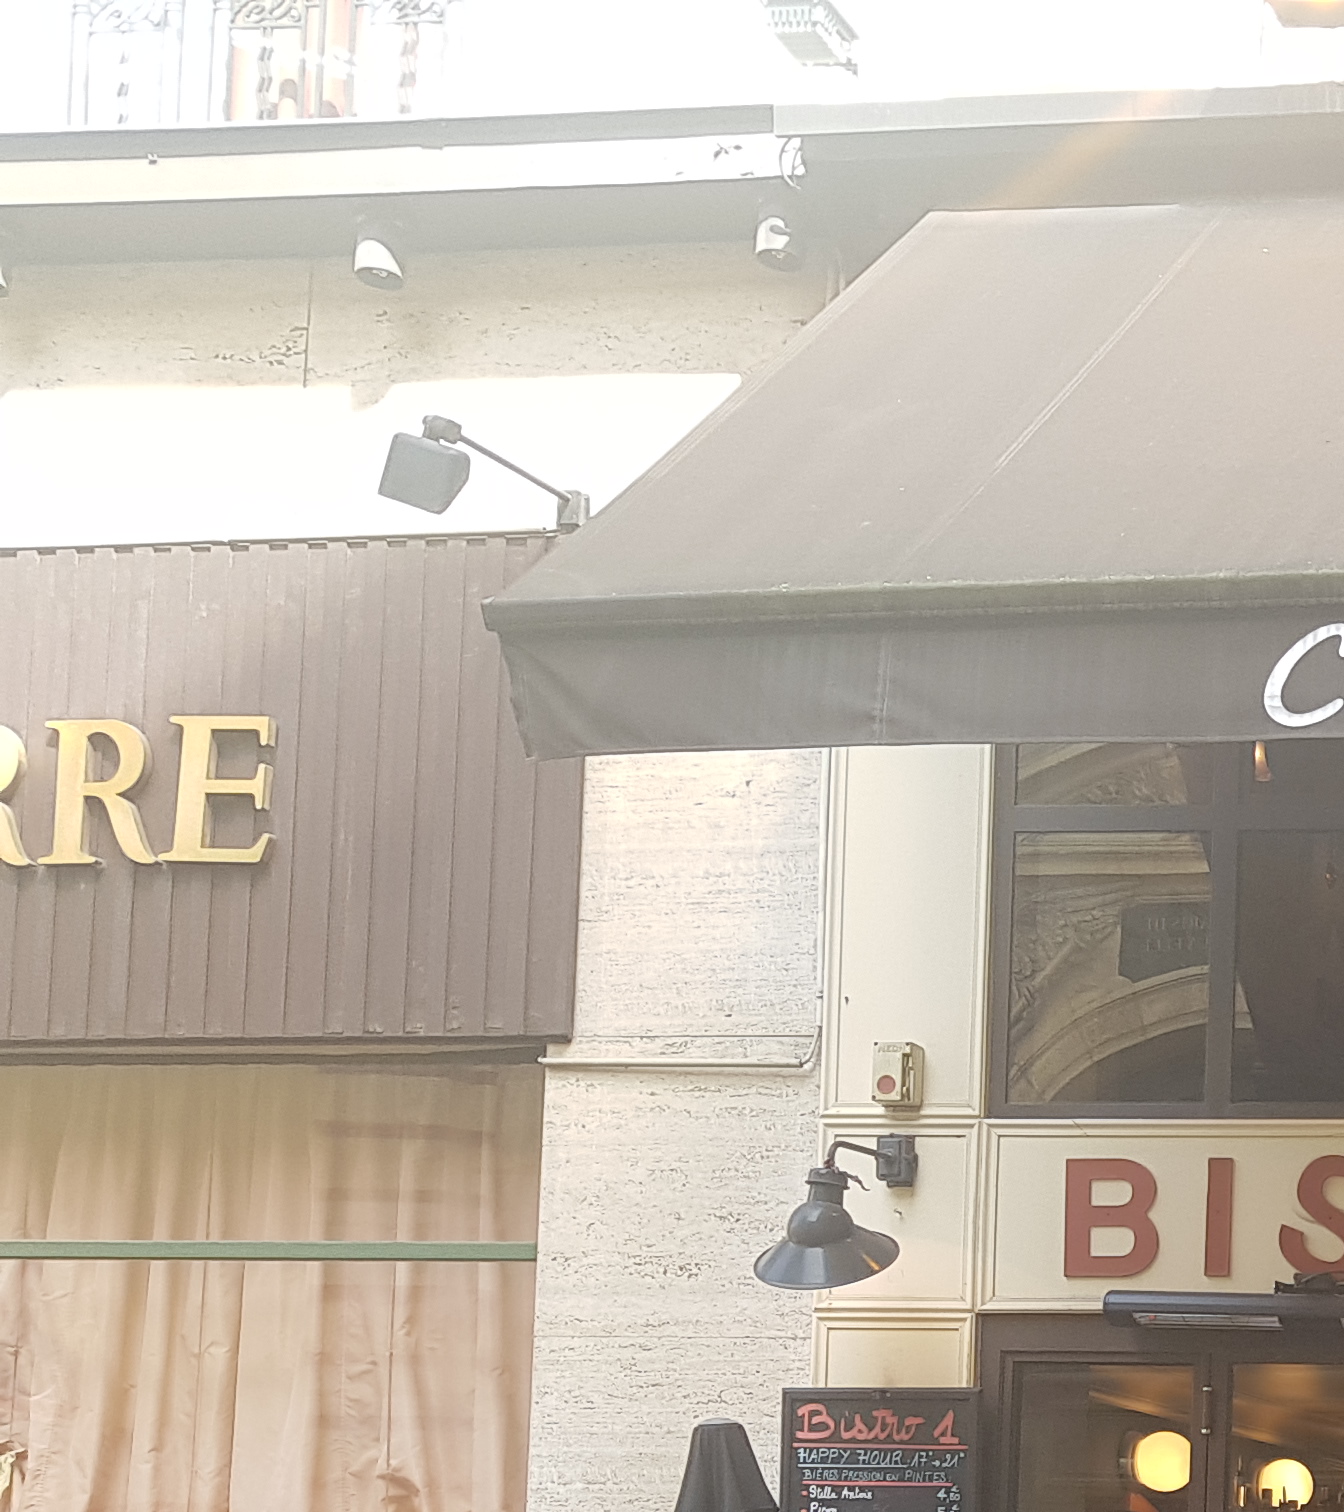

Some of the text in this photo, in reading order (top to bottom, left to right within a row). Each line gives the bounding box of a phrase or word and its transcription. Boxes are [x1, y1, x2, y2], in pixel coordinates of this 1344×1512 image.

[795, 1402, 960, 1444] Bistro 1
[797, 1448, 850, 1464] HAPPY
[856, 1450, 903, 1466] HOUR
